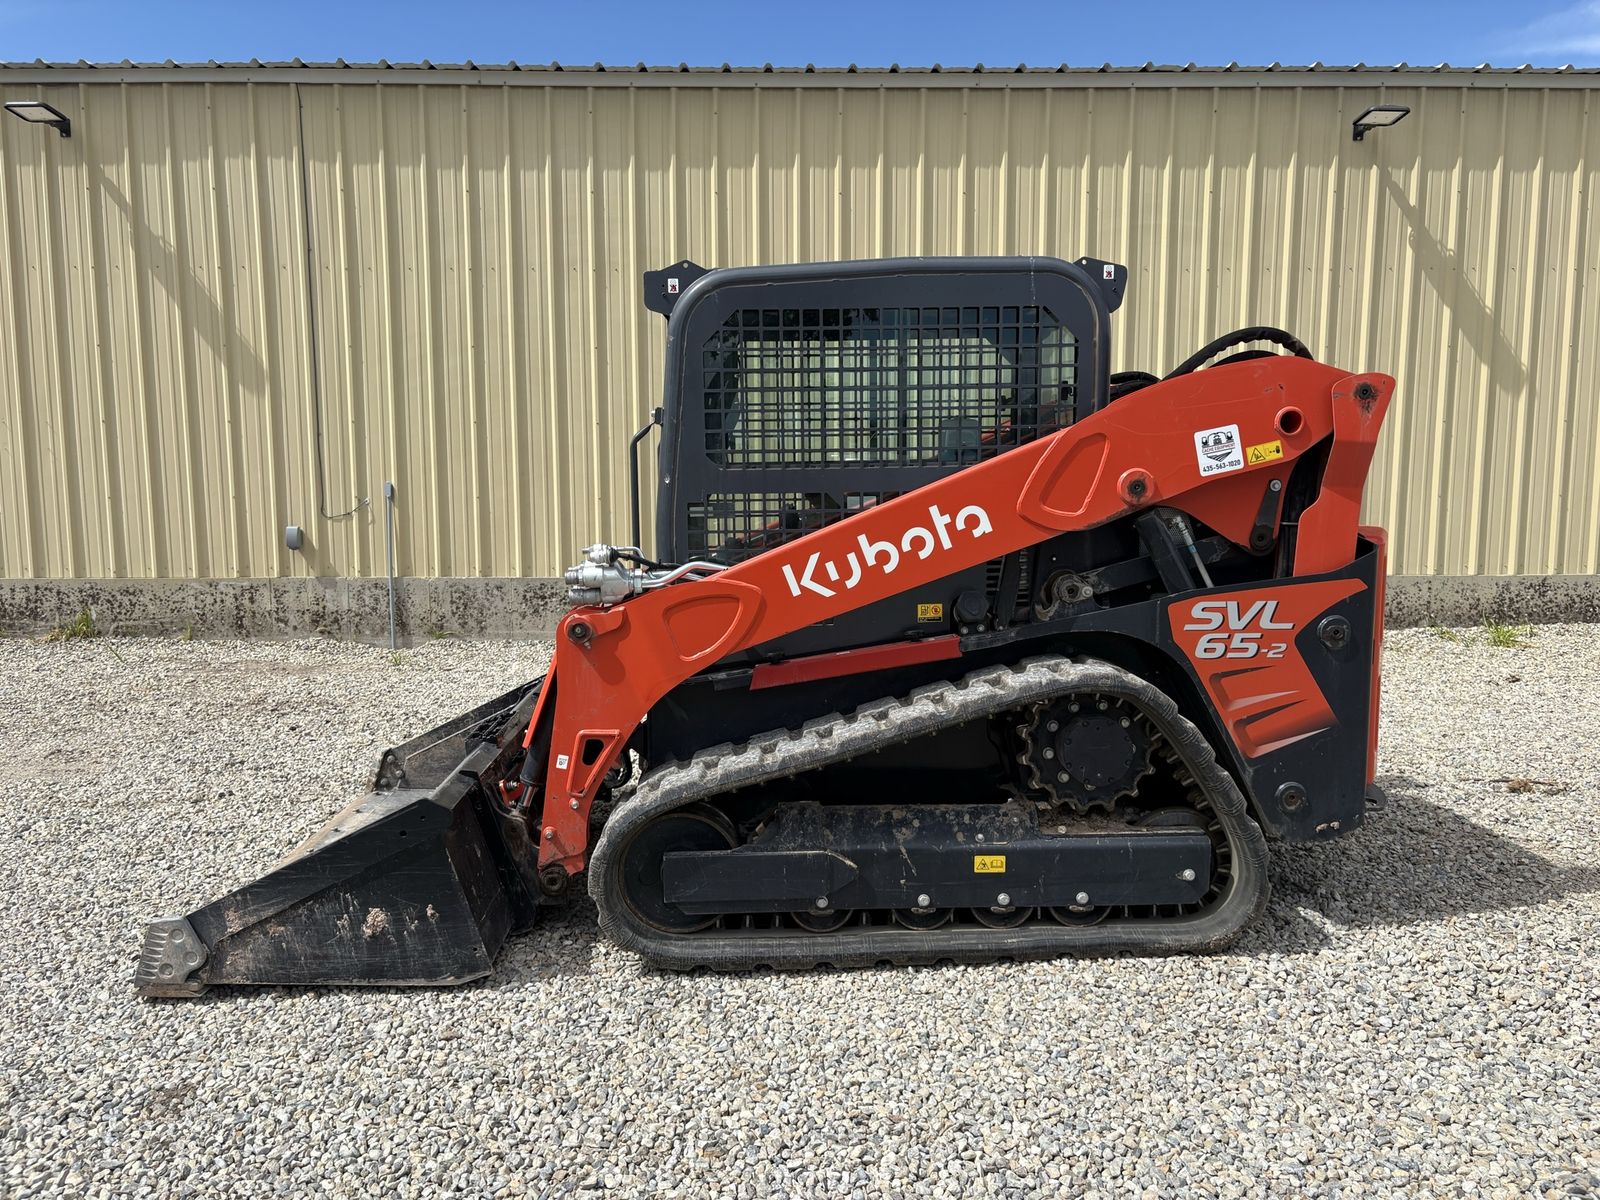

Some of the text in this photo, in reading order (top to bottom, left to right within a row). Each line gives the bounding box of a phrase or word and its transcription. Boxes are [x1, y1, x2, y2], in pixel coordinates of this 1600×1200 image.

[1203, 459, 1241, 472] 435-563-1020
[781, 504, 993, 598] Kubota
[1183, 600, 1295, 631] SVL
[1194, 632, 1288, 659] 65-2
